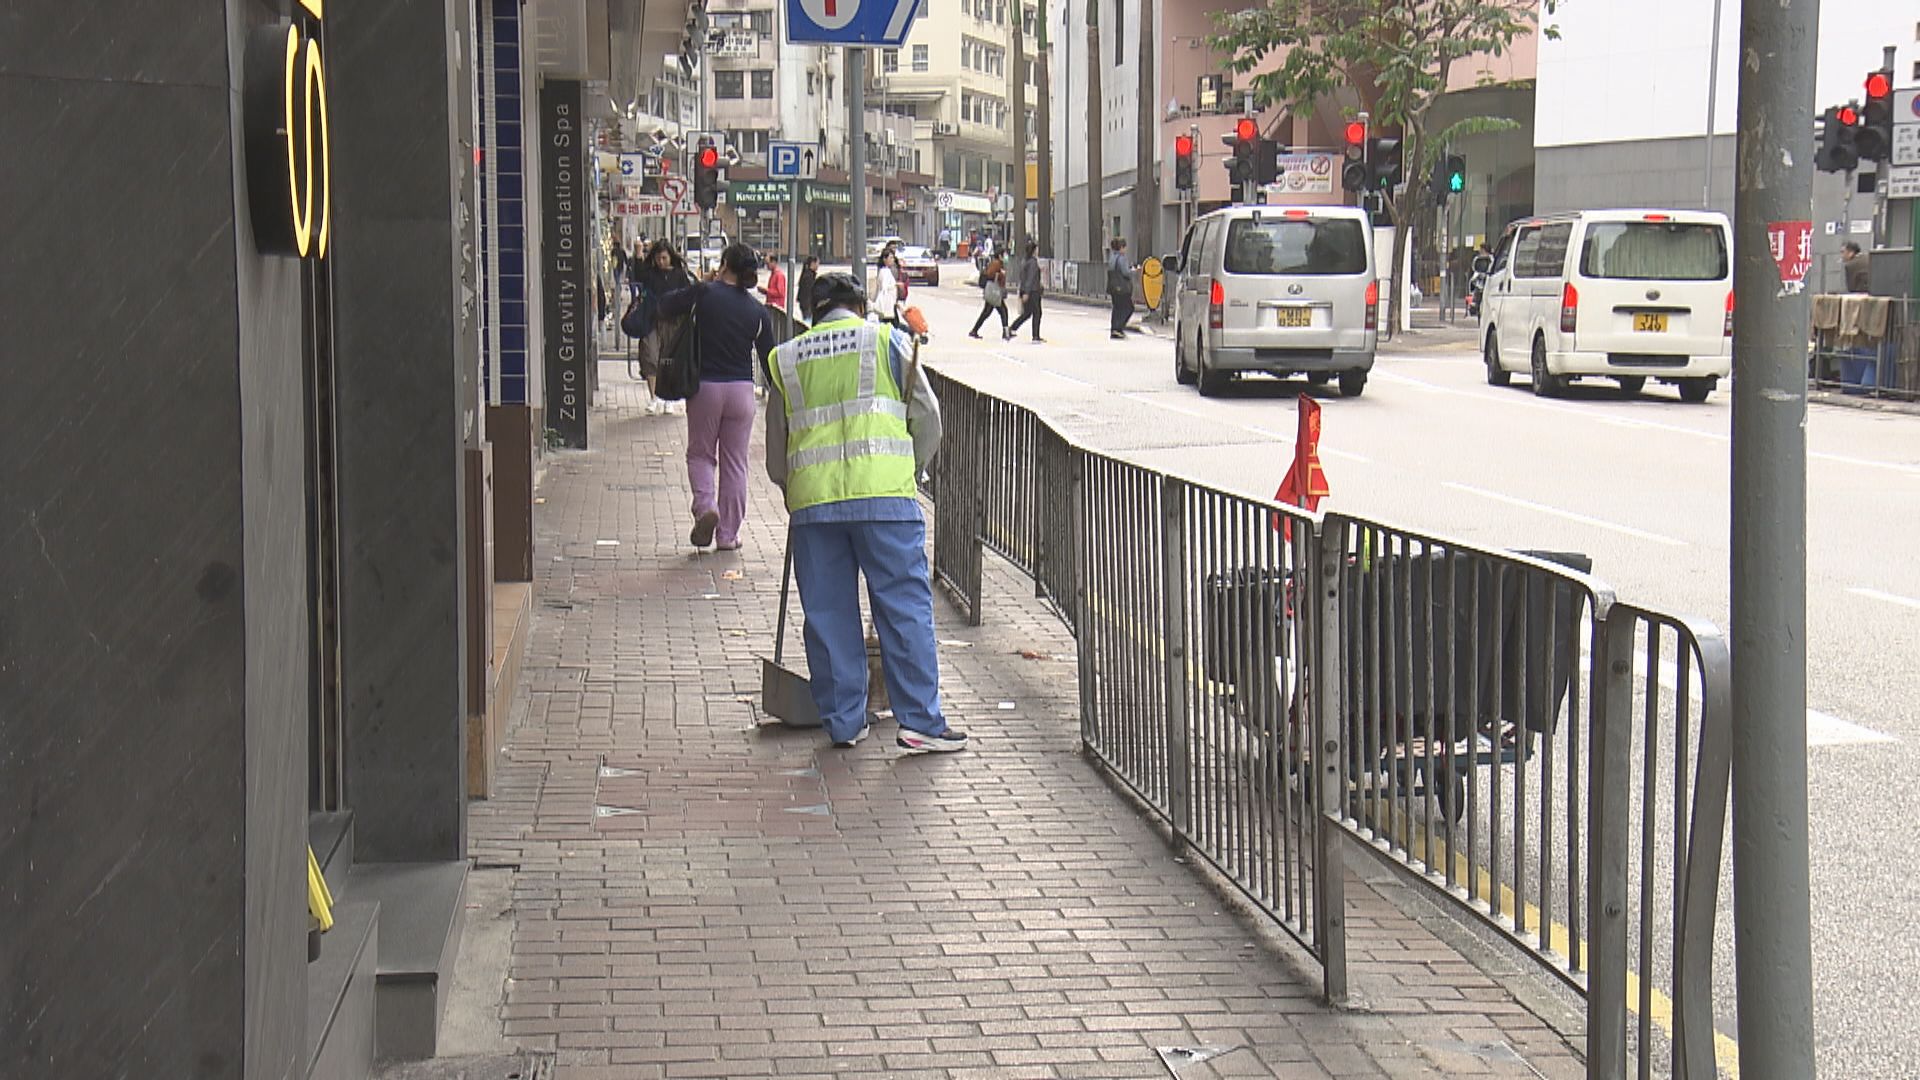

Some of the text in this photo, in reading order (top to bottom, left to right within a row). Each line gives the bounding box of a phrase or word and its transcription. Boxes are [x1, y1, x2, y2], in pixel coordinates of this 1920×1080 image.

[778, 148, 795, 173] P
[553, 103, 577, 420] Zero Gravity Floatation Spa
